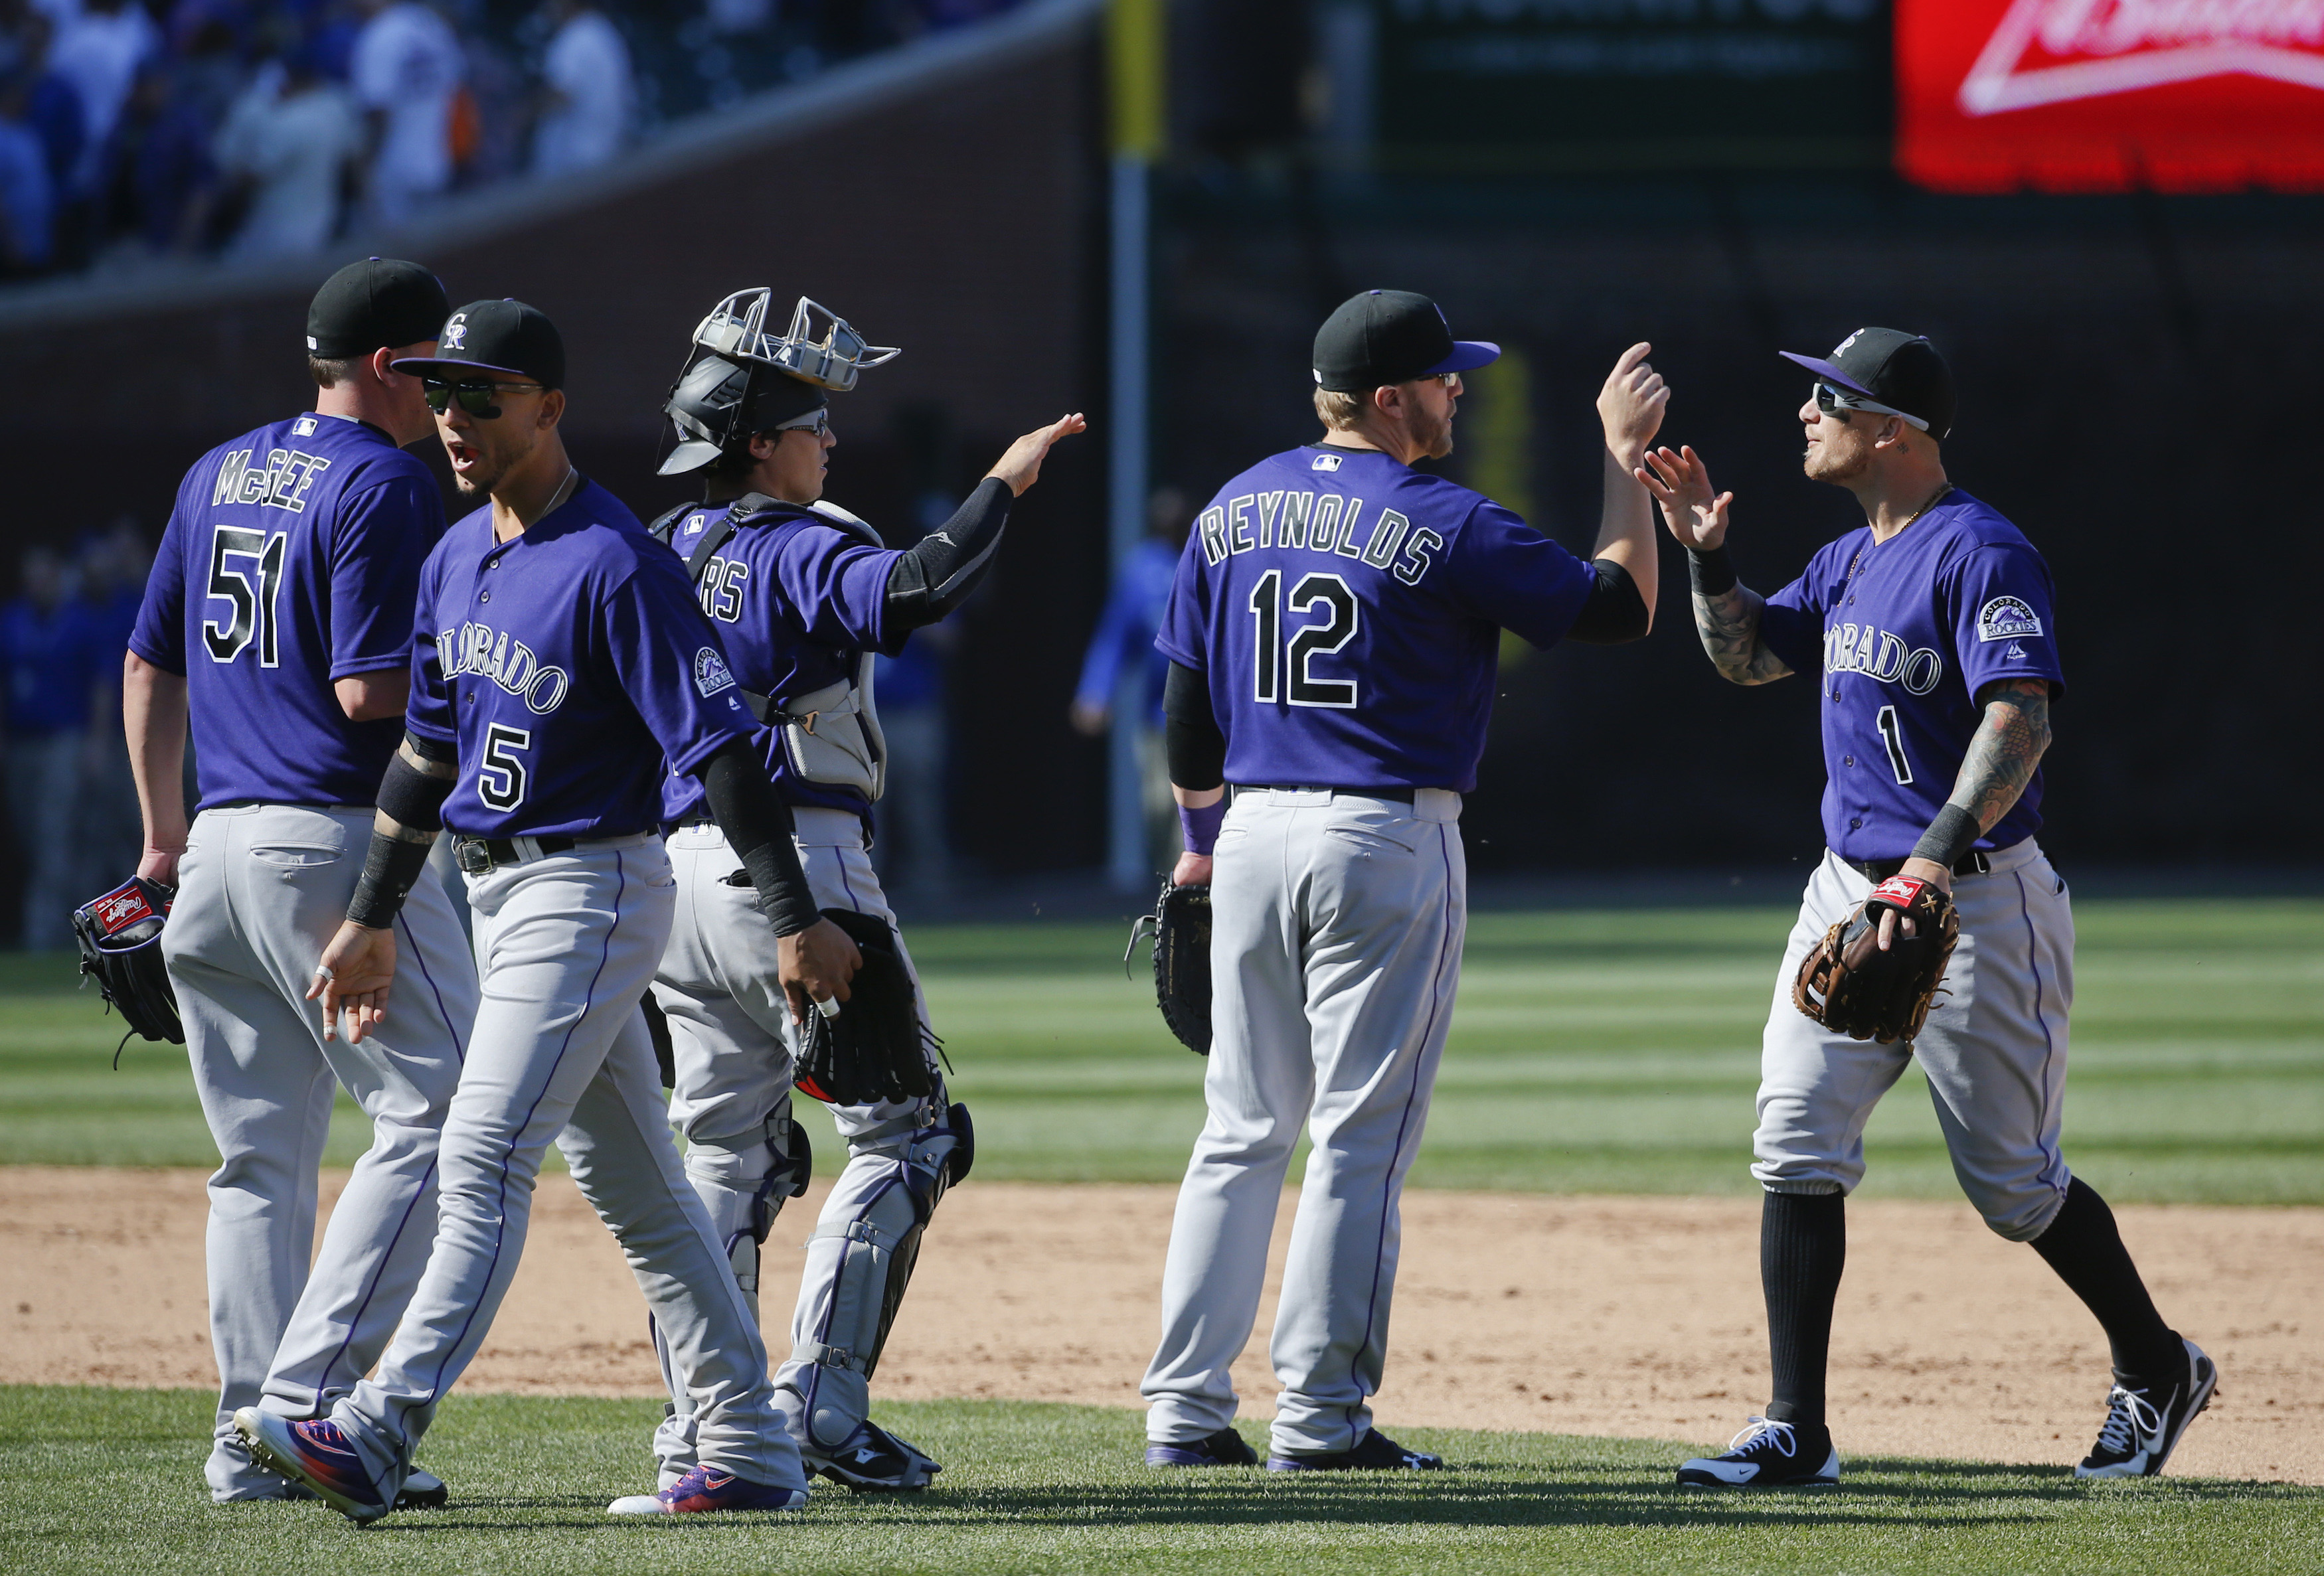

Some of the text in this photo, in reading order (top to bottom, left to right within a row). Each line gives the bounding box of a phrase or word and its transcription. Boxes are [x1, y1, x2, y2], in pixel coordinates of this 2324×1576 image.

[212, 448, 332, 514] McGEE
[1199, 490, 1444, 586] REYNOLDS
[203, 524, 288, 668] 51
[1984, 599, 2031, 621] COLORADO
[1985, 620, 2036, 636] ROCKIES
[1249, 569, 1359, 708] 12
[477, 721, 530, 813] 5
[1876, 705, 1914, 785] 1
[106, 896, 141, 923] Rawlings
